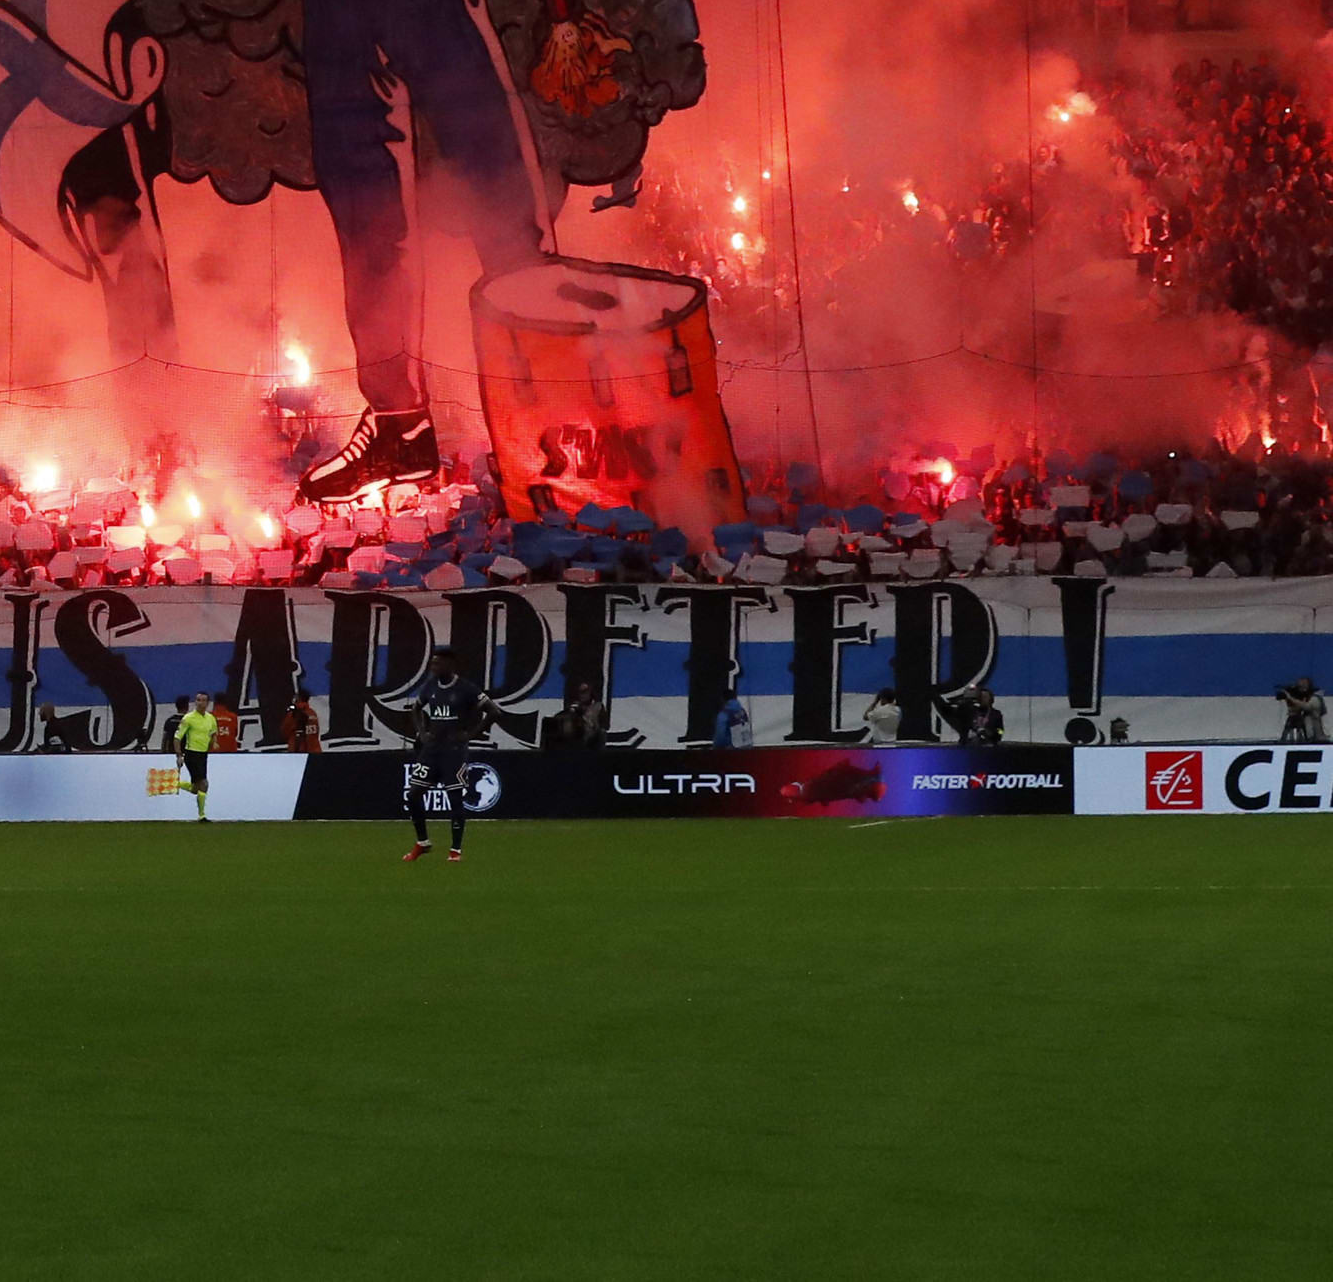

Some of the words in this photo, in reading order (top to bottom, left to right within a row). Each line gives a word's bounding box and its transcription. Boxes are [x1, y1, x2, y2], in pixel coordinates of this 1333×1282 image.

[412, 762, 430, 779] 25
[1224, 749, 1333, 811] CE
[613, 773, 755, 795] ULTRA
[912, 774, 969, 790] FASTER
[985, 773, 1064, 789] FOOTBALL
